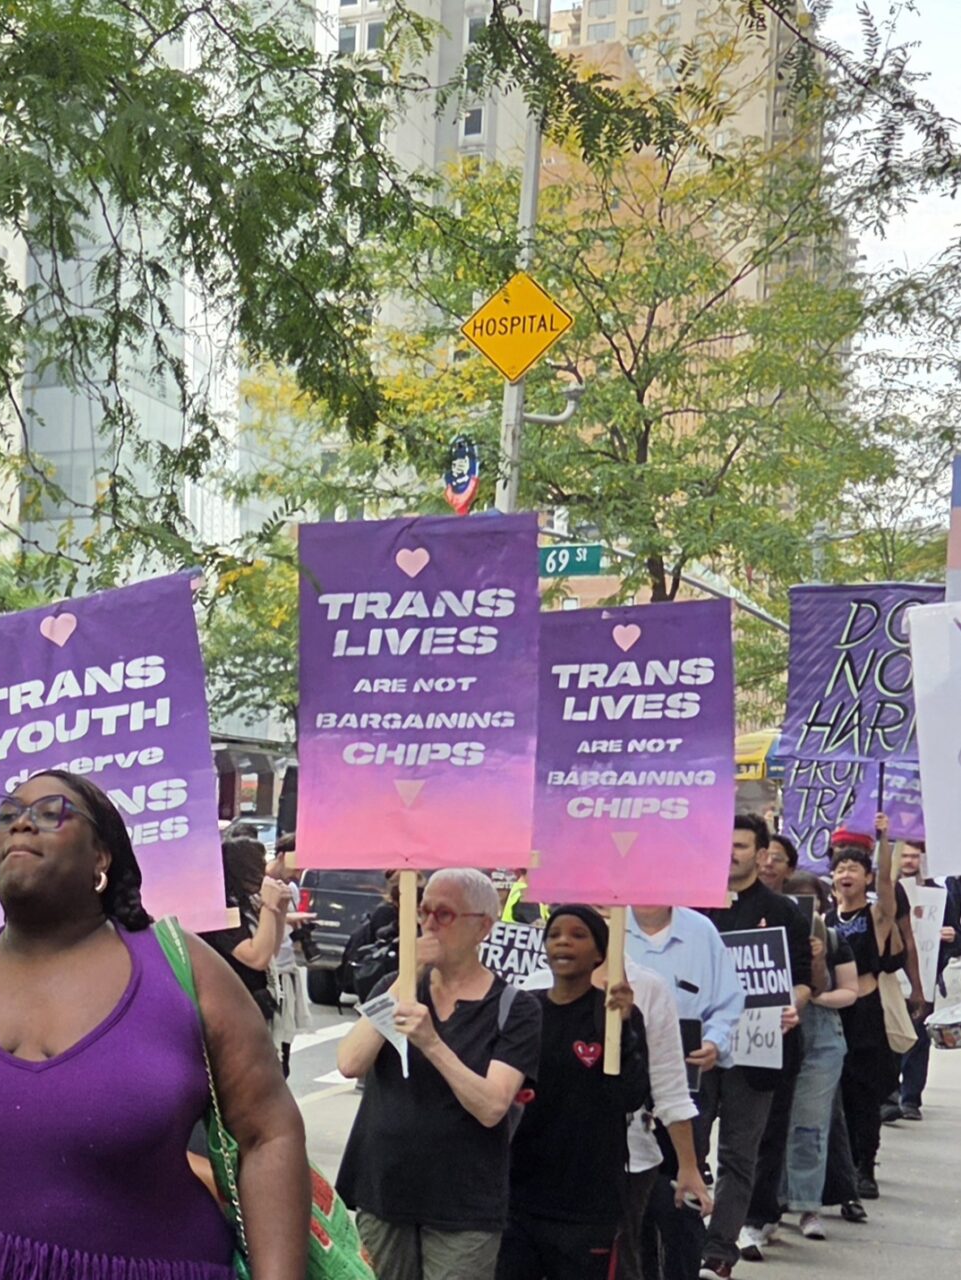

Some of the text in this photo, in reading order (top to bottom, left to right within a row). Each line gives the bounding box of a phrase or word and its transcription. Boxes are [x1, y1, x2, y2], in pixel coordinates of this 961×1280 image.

[472, 313, 560, 338] HOSPITAL
[545, 548, 570, 573] 69
[318, 588, 516, 620] TRANS
[333, 625, 499, 657] LIVES
[353, 676, 478, 693] ARE NOT
[551, 657, 715, 689] TRANS
[562, 692, 701, 721] LIVES
[315, 711, 515, 729] BARGAINING
[795, 699, 918, 757] HAR
[342, 741, 486, 766] CHIPS
[577, 738, 683, 754] ARE NOT
[4, 746, 165, 794] derve
[547, 770, 716, 786] BARGAINING
[567, 796, 690, 820] CHIPS
[490, 921, 547, 953] EFEN
